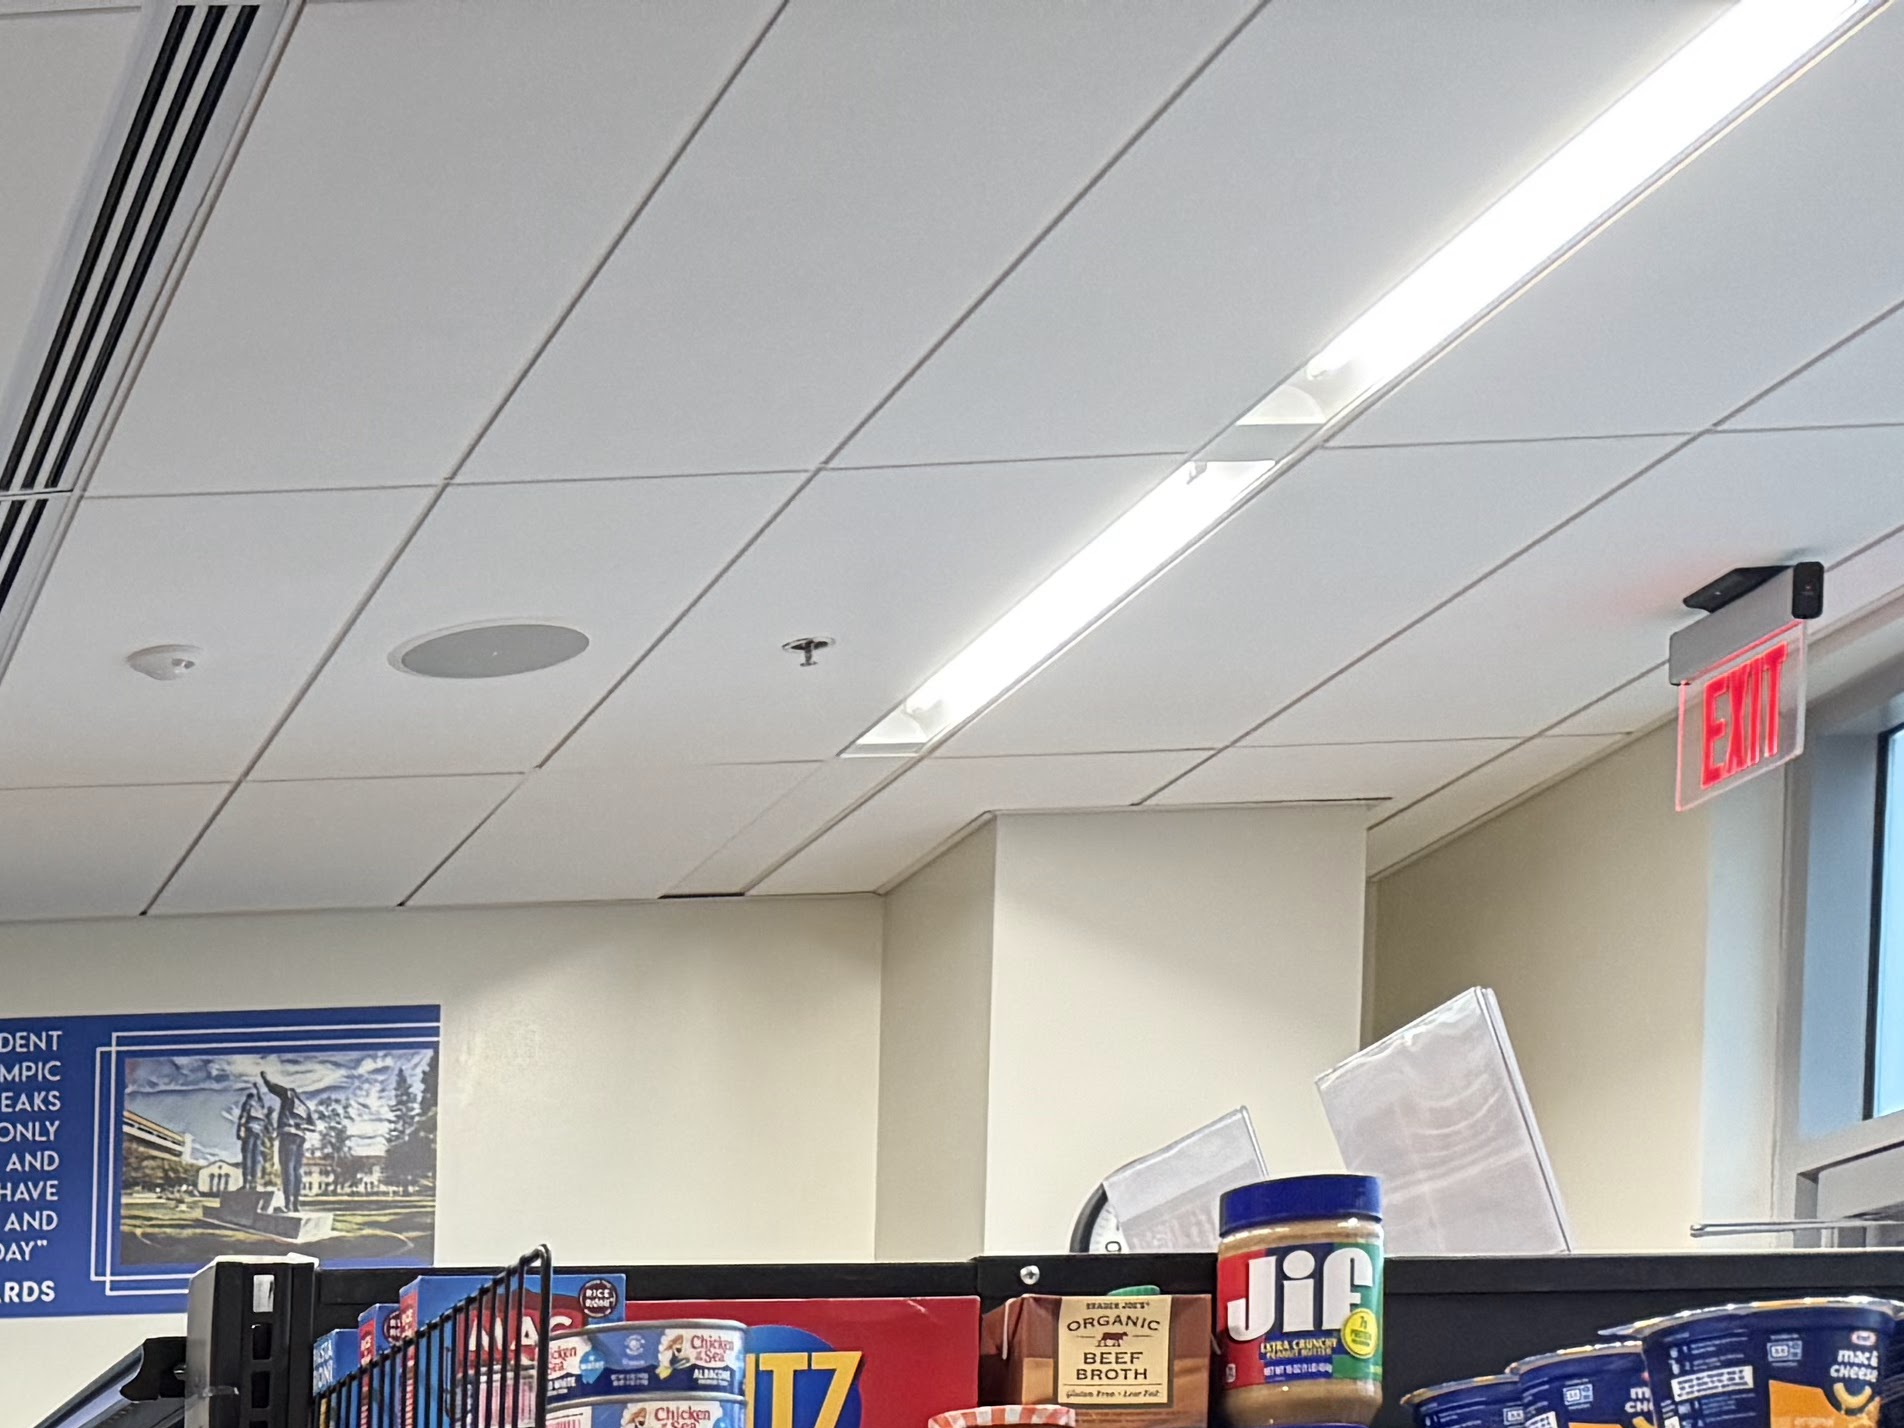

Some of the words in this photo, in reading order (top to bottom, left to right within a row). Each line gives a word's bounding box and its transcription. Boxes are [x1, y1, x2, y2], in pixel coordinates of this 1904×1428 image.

[1700, 641, 1788, 791] EXIT
[6, 1151, 59, 1173] AND
[4, 1211, 58, 1231] AND
[1227, 1248, 1373, 1341] Jif
[1066, 1315, 1161, 1332] ORGANIC
[691, 1335, 734, 1351] Chicken
[704, 1349, 725, 1363] Sea
[1083, 1351, 1143, 1365] BEEF
[1076, 1368, 1148, 1380] BROTH
[655, 1407, 711, 1422] Chicken
